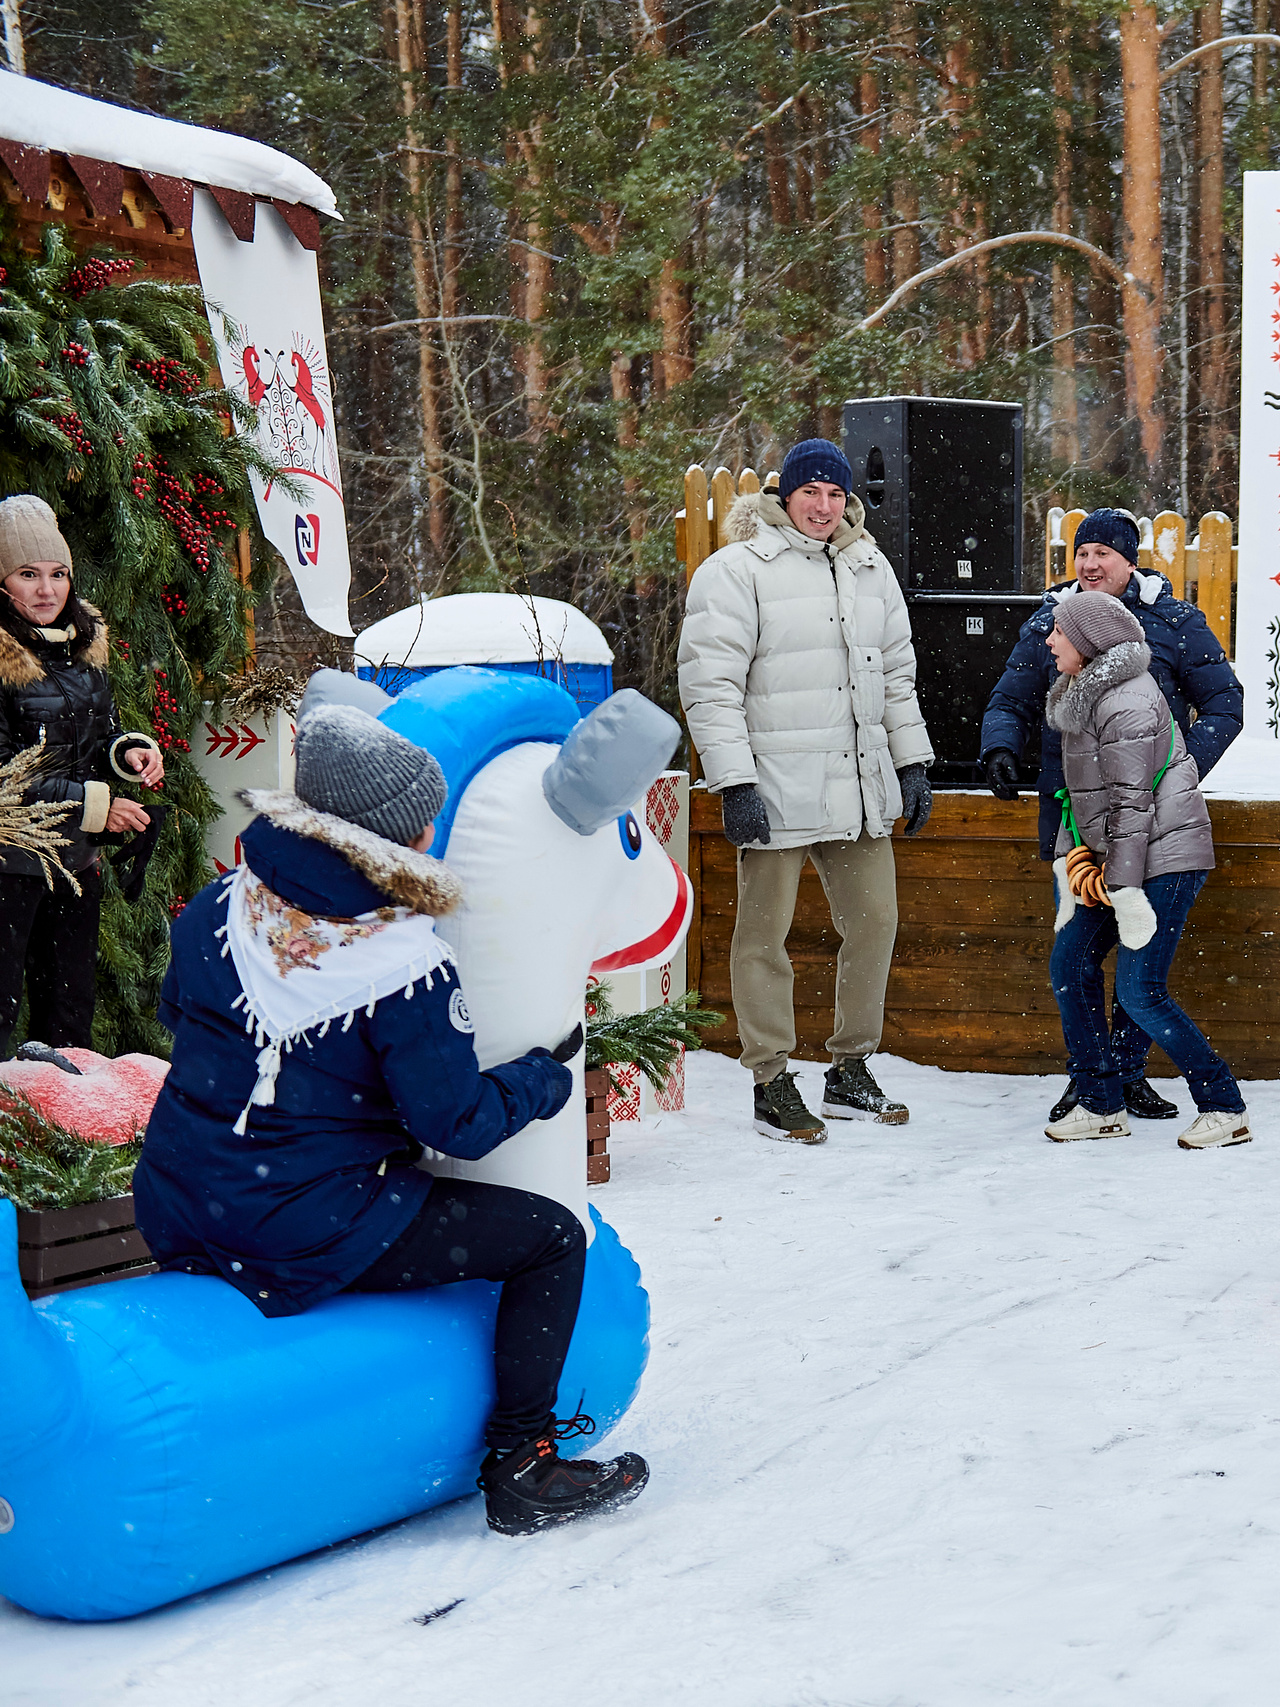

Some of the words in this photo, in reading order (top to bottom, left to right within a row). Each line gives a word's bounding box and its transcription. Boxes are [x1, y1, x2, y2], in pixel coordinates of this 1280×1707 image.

[301, 532, 311, 548] N
[959, 562, 971, 572] HK
[968, 618, 982, 629] HK
